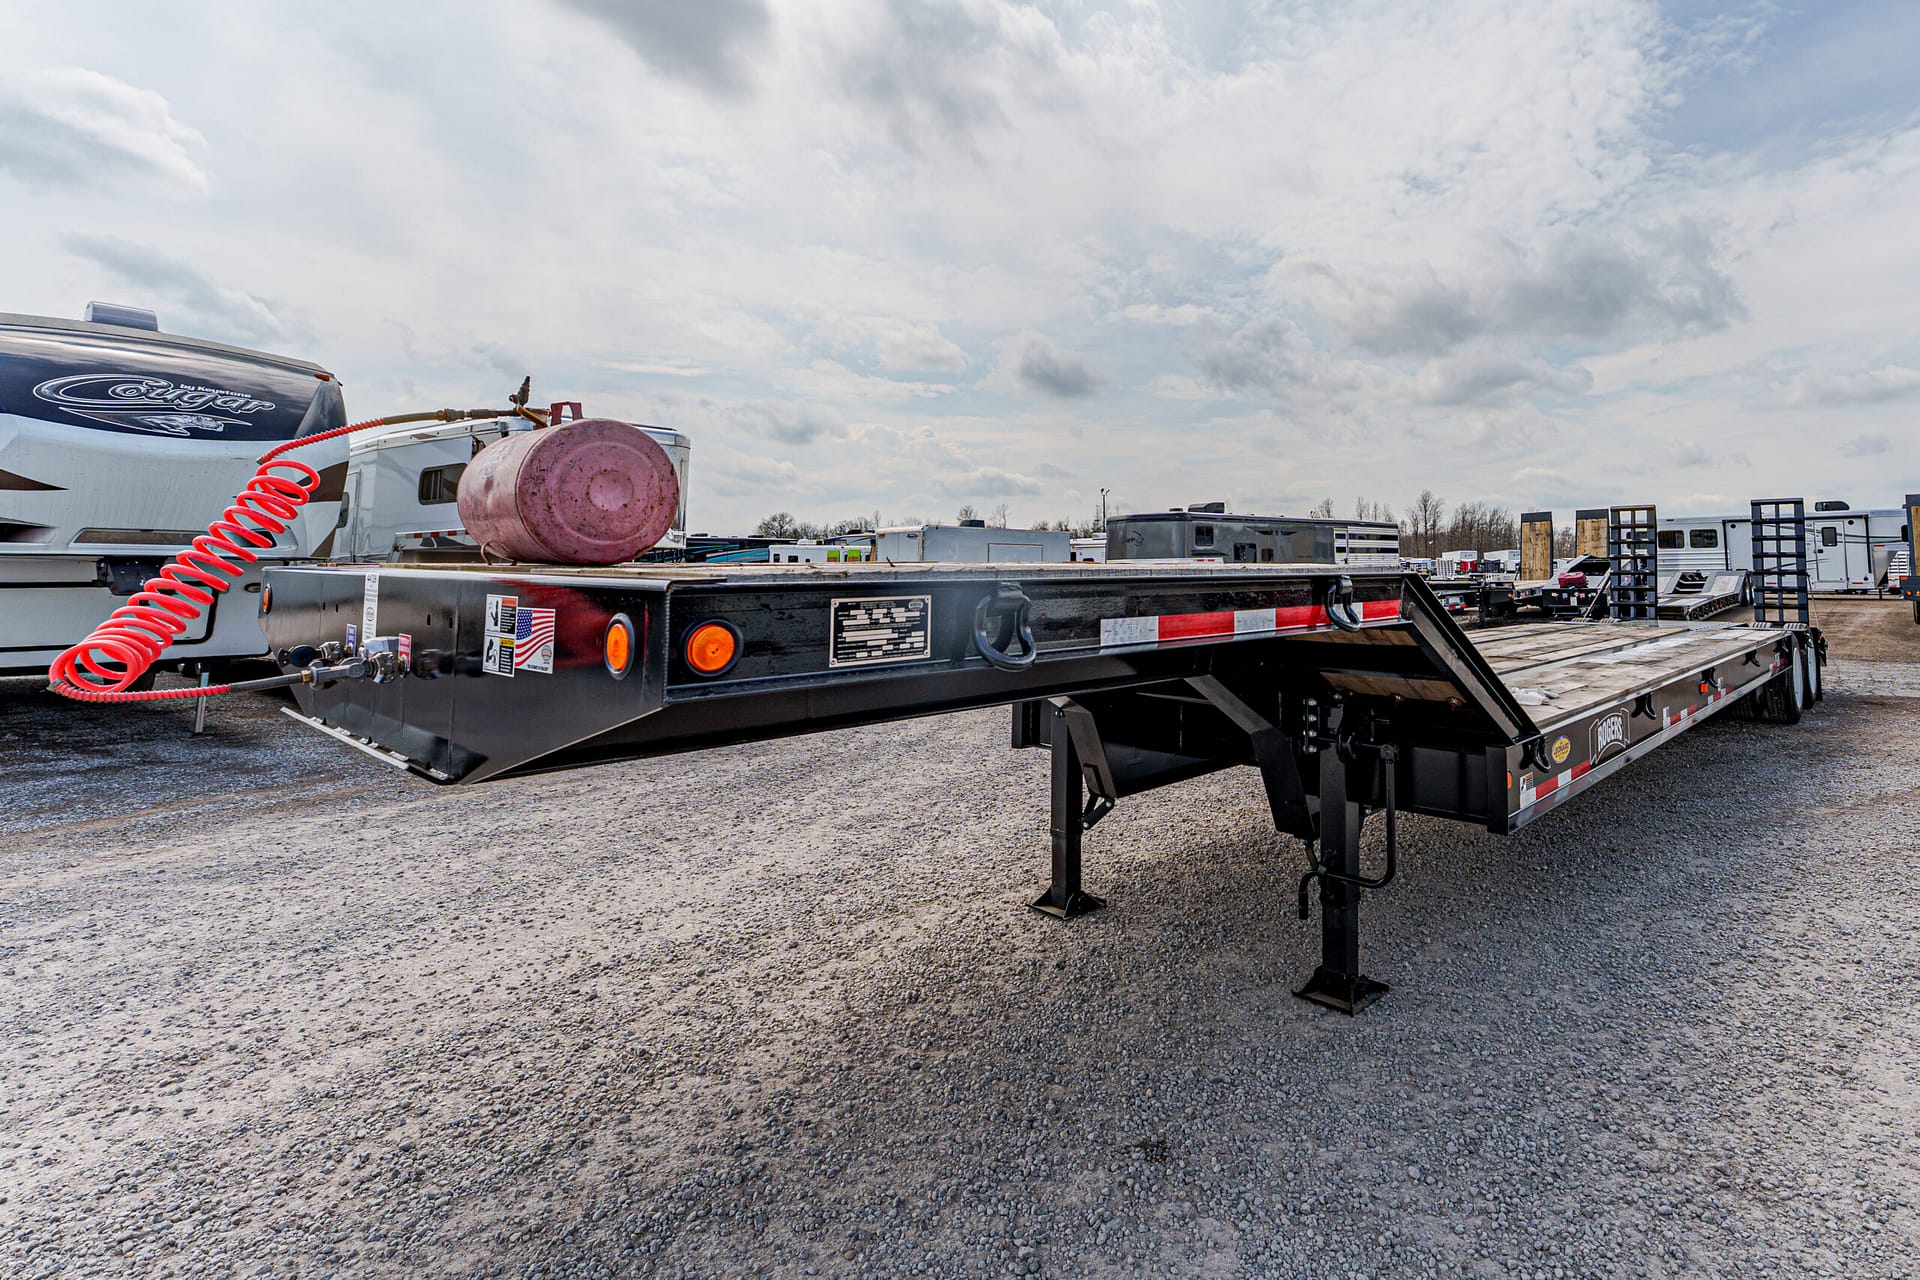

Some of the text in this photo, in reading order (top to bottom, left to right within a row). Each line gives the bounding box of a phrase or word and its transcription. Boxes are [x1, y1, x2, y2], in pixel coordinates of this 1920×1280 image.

[33, 373, 276, 414] Cougar
[179, 382, 253, 399] by Keystone
[1597, 716, 1623, 752] ROGERS
